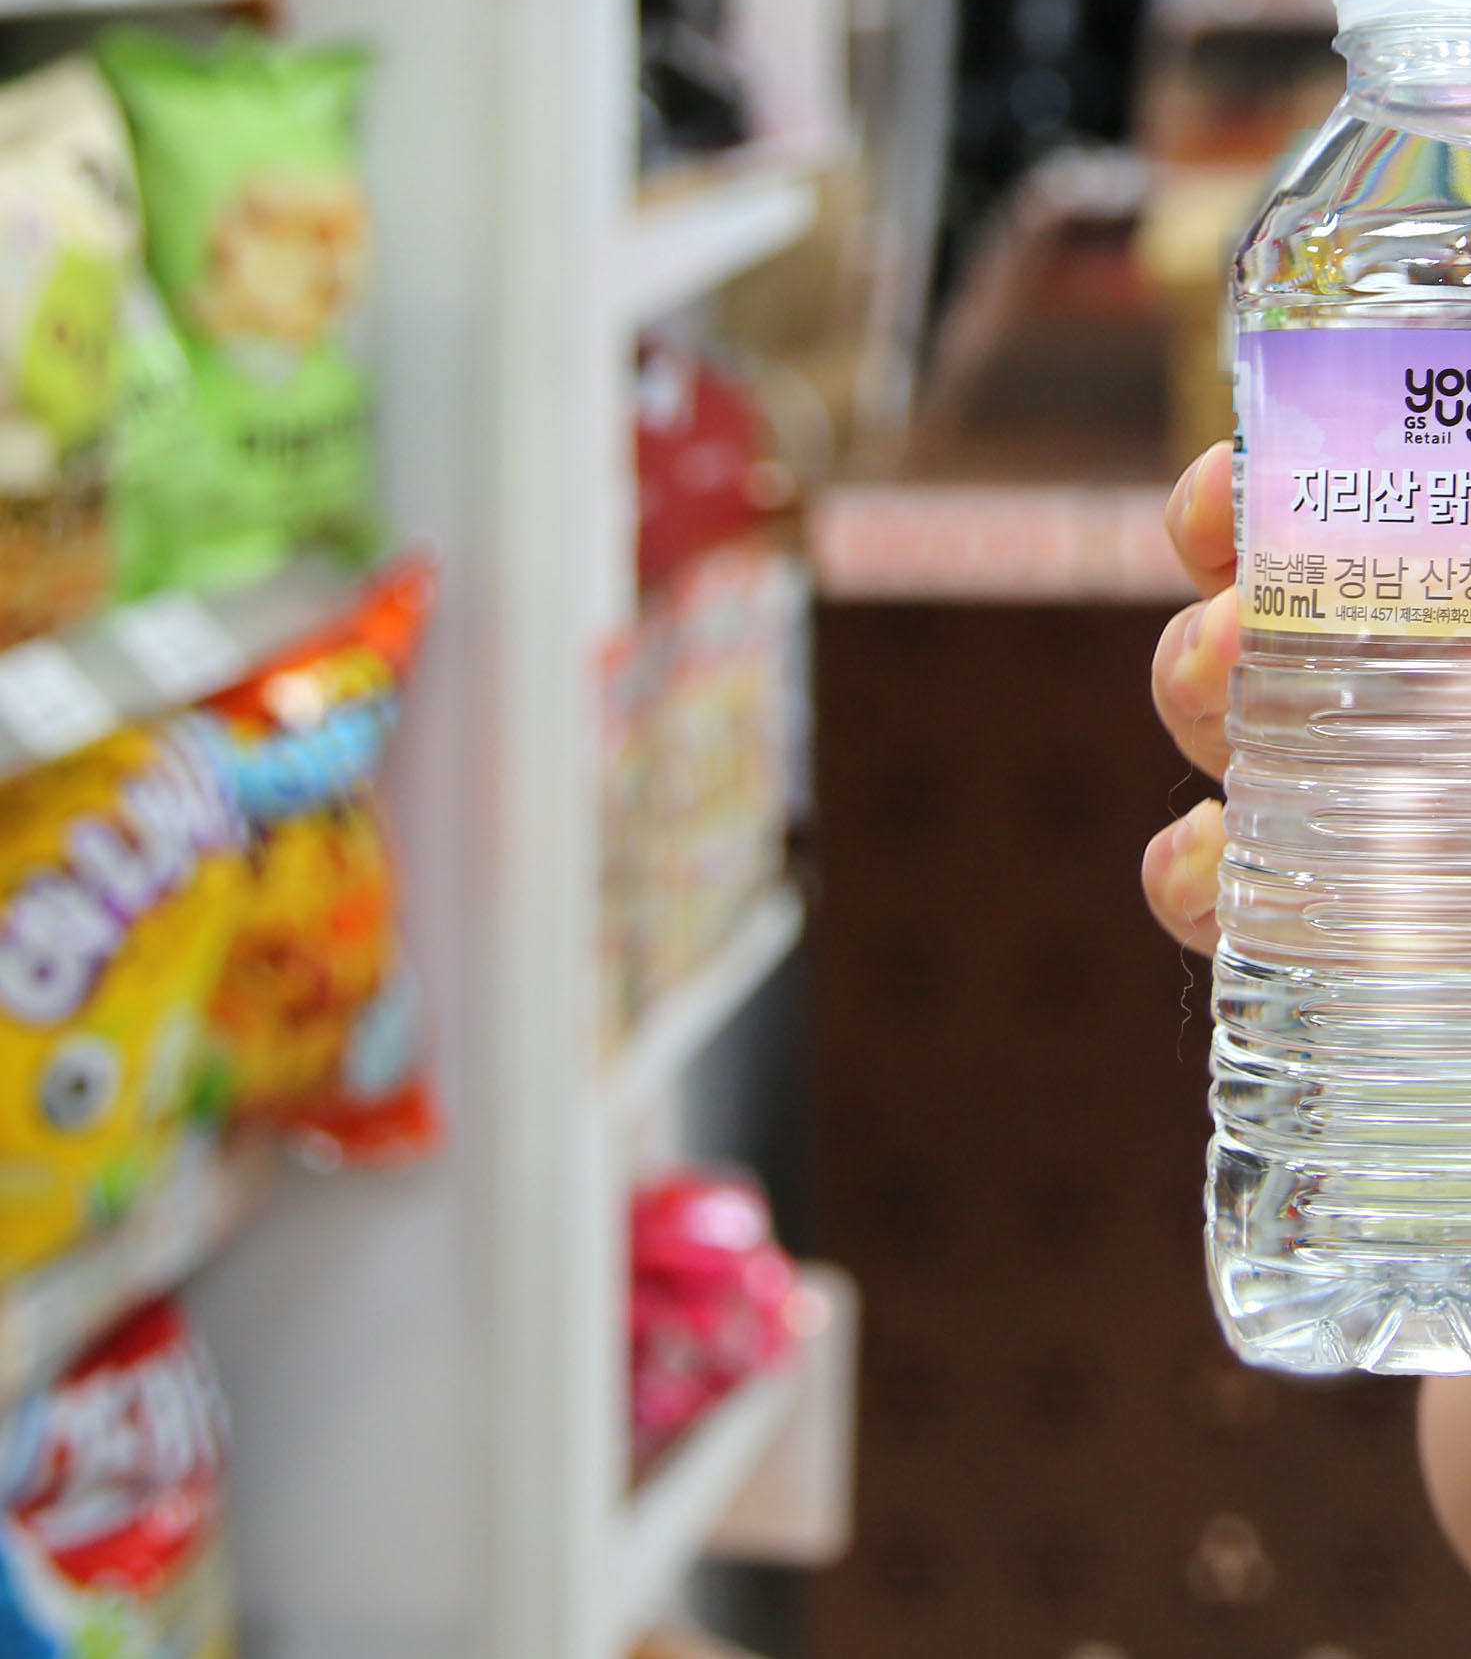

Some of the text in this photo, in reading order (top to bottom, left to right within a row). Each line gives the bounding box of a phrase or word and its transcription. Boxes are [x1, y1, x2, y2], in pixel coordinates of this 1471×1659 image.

[1404, 416, 1427, 430] GS
[1404, 431, 1452, 445] Retail
[1290, 466, 1421, 523] 지리산
[1254, 552, 1328, 585] 먹는샘물
[1334, 555, 1409, 600] 경남
[1253, 585, 1326, 619] 500 mL
